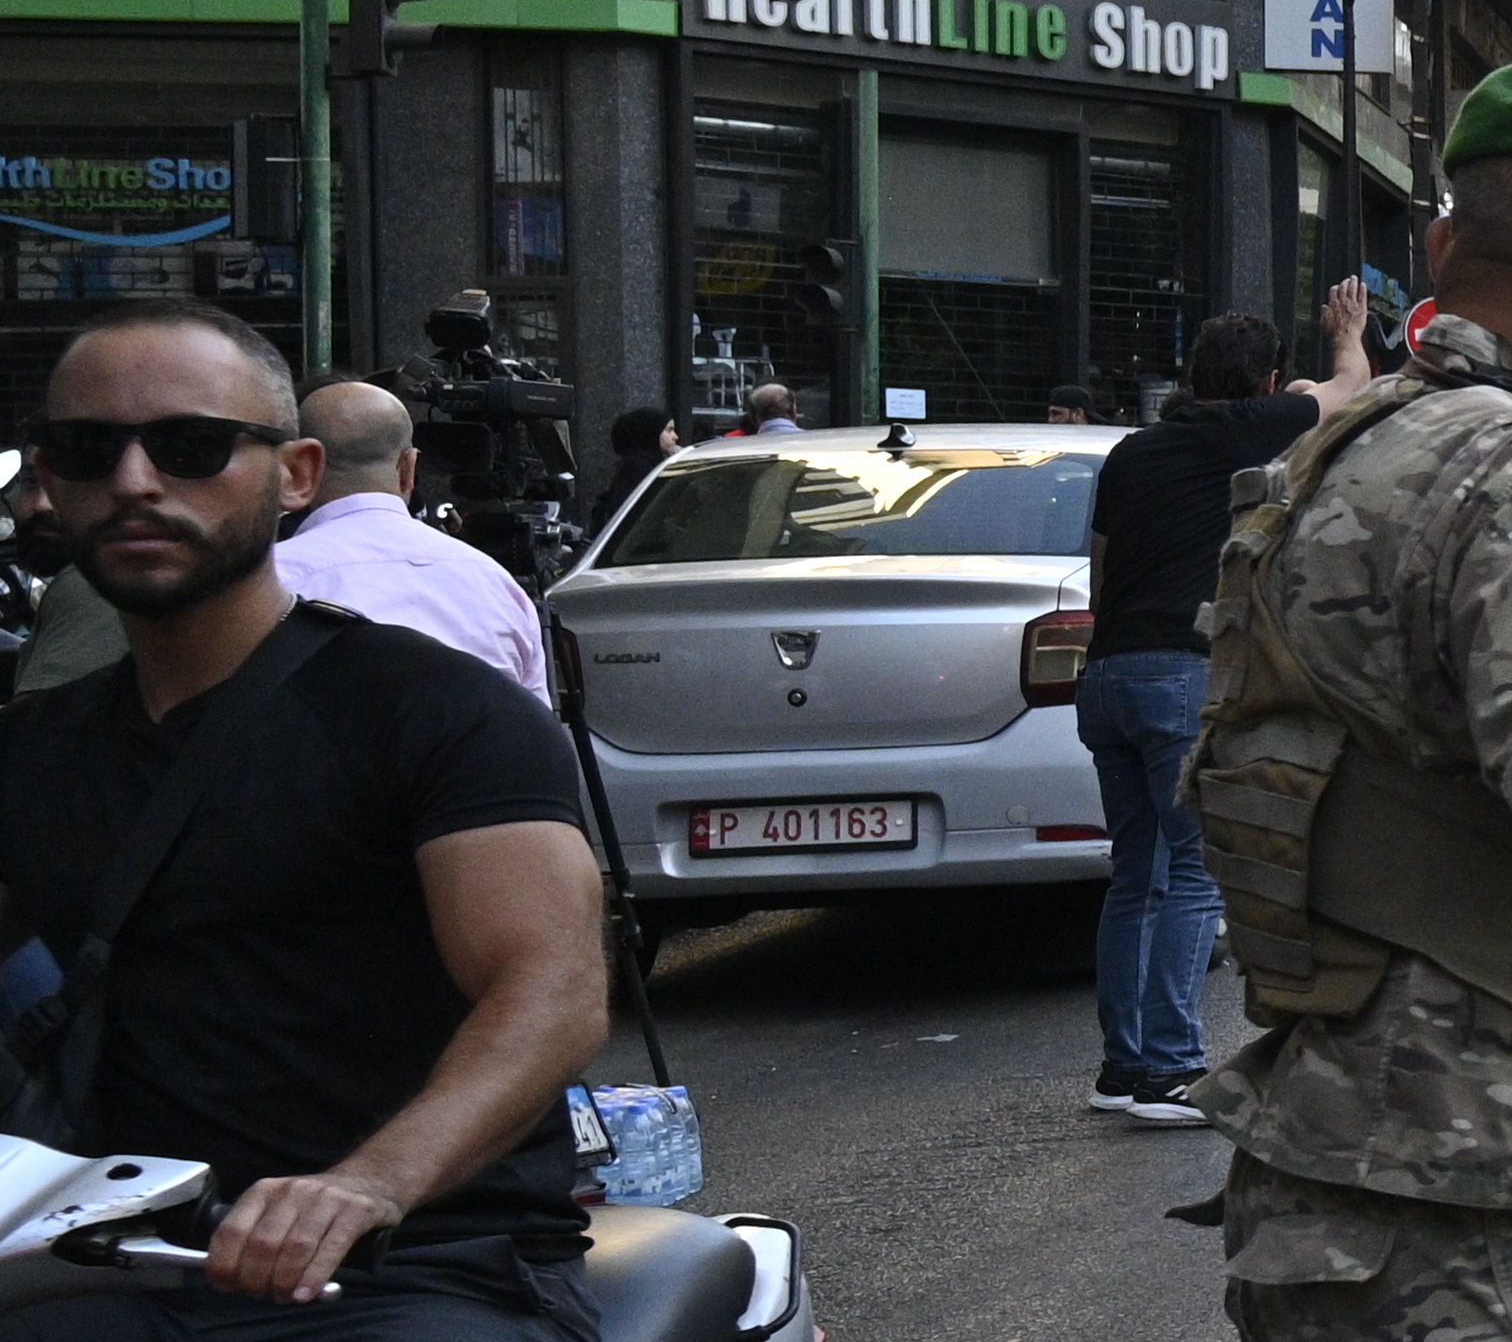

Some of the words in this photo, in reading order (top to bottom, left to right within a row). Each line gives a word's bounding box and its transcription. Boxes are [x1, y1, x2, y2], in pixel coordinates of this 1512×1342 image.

[1090, 1, 1229, 89] Shop
[719, 812, 739, 845] P
[763, 806, 888, 843] 401163
